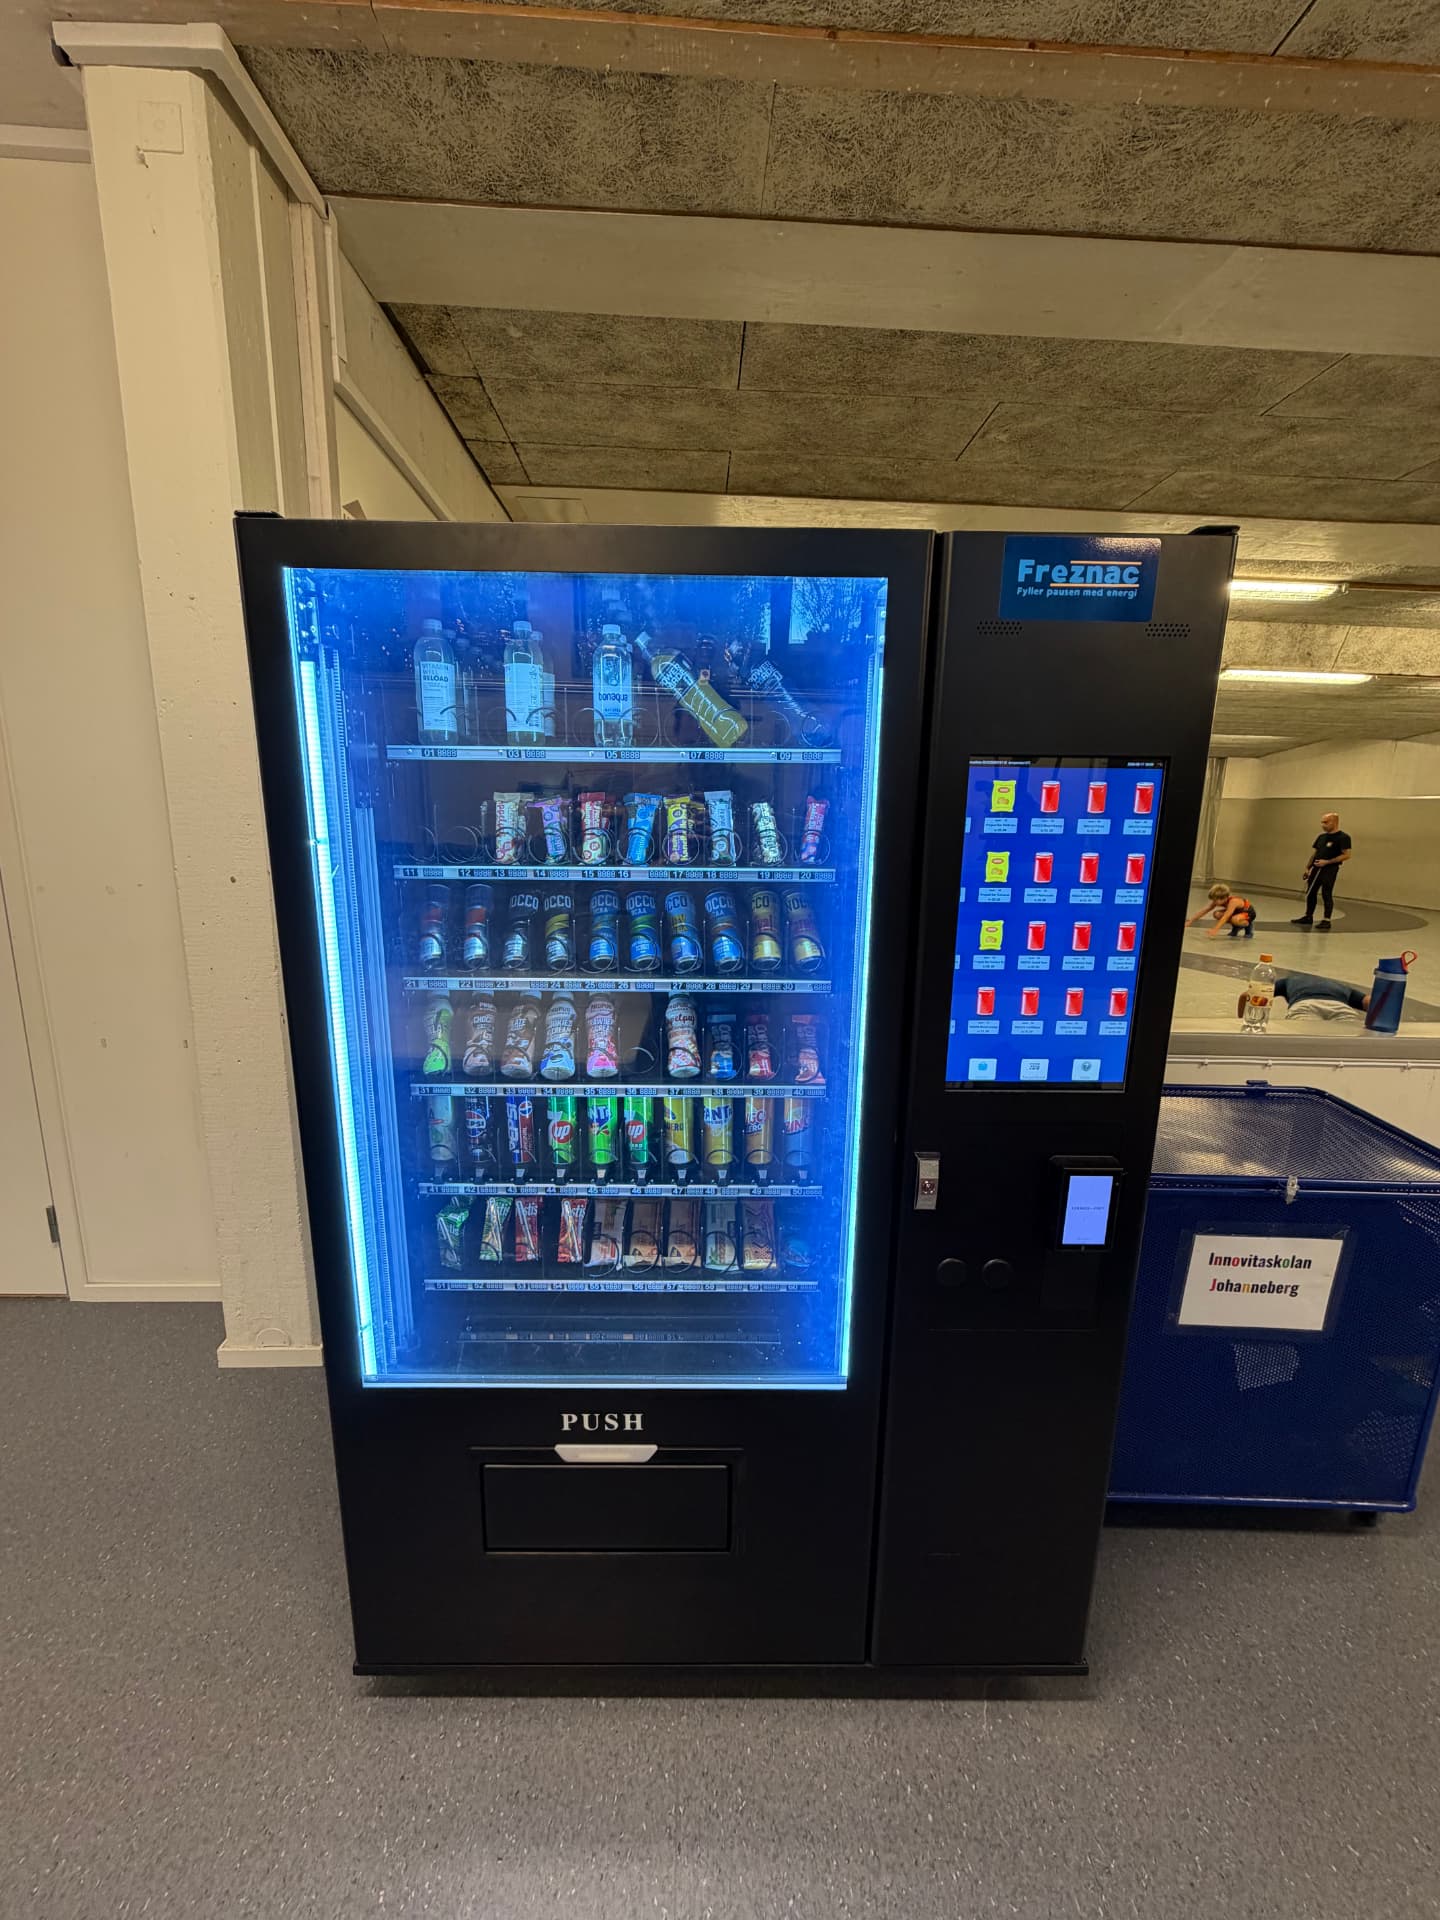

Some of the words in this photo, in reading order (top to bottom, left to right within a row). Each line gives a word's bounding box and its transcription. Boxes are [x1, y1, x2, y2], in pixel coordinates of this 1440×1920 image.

[1017, 559, 1141, 585] Freznac
[1016, 587, 1044, 598] Fyller
[1046, 588, 1080, 598] pausen
[1082, 588, 1104, 597] med
[1106, 589, 1138, 600] energi
[422, 674, 450, 683] RELOAD
[424, 749, 435, 757] 01
[508, 750, 521, 758] 03
[606, 750, 618, 758] 05
[690, 752, 702, 760] 07
[779, 752, 792, 760] 09
[459, 869, 472, 877] 12
[493, 869, 506, 877] 13
[535, 870, 547, 878] 14
[583, 870, 595, 878] 15
[617, 871, 629, 879] 16
[672, 871, 683, 879] 17
[705, 871, 717, 879] 18
[800, 872, 812, 880] 20
[406, 980, 417, 988] 21
[460, 980, 472, 988] 22
[495, 980, 507, 988] 23
[585, 981, 597, 989] 25
[617, 982, 629, 990] 26
[672, 982, 683, 990] 27
[705, 982, 716, 990] 28
[1208, 1252, 1312, 1270] Innovitaskolan
[1209, 1278, 1300, 1298] Johanneberg
[560, 1412, 644, 1431] PUSH
